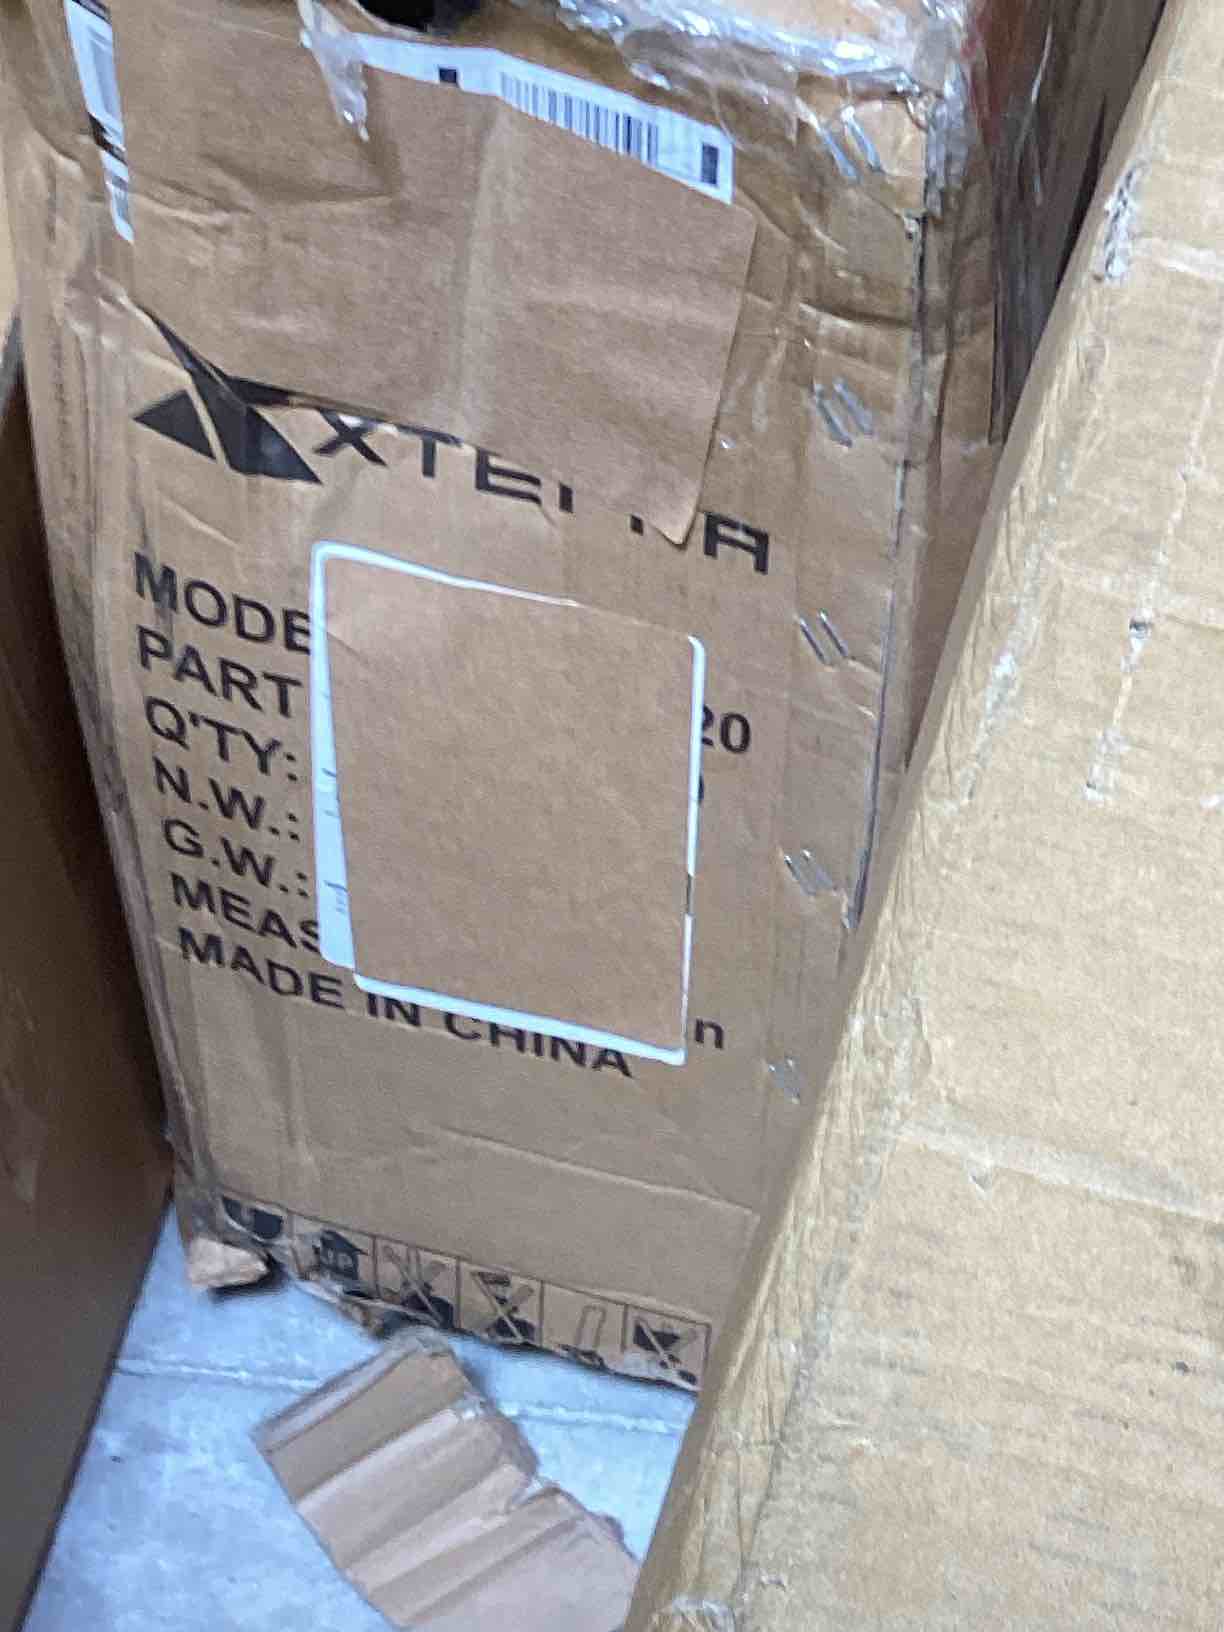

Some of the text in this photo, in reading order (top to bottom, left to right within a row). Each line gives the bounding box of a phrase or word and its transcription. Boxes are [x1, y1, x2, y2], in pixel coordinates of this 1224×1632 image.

[314, 408, 768, 575] XTEA
[136, 624, 302, 718] PART
[145, 695, 298, 776] Q'TY:
[153, 755, 299, 841] N.W.:
[164, 818, 308, 898] G.W.:
[178, 927, 633, 1079] MADE IN CHINA
